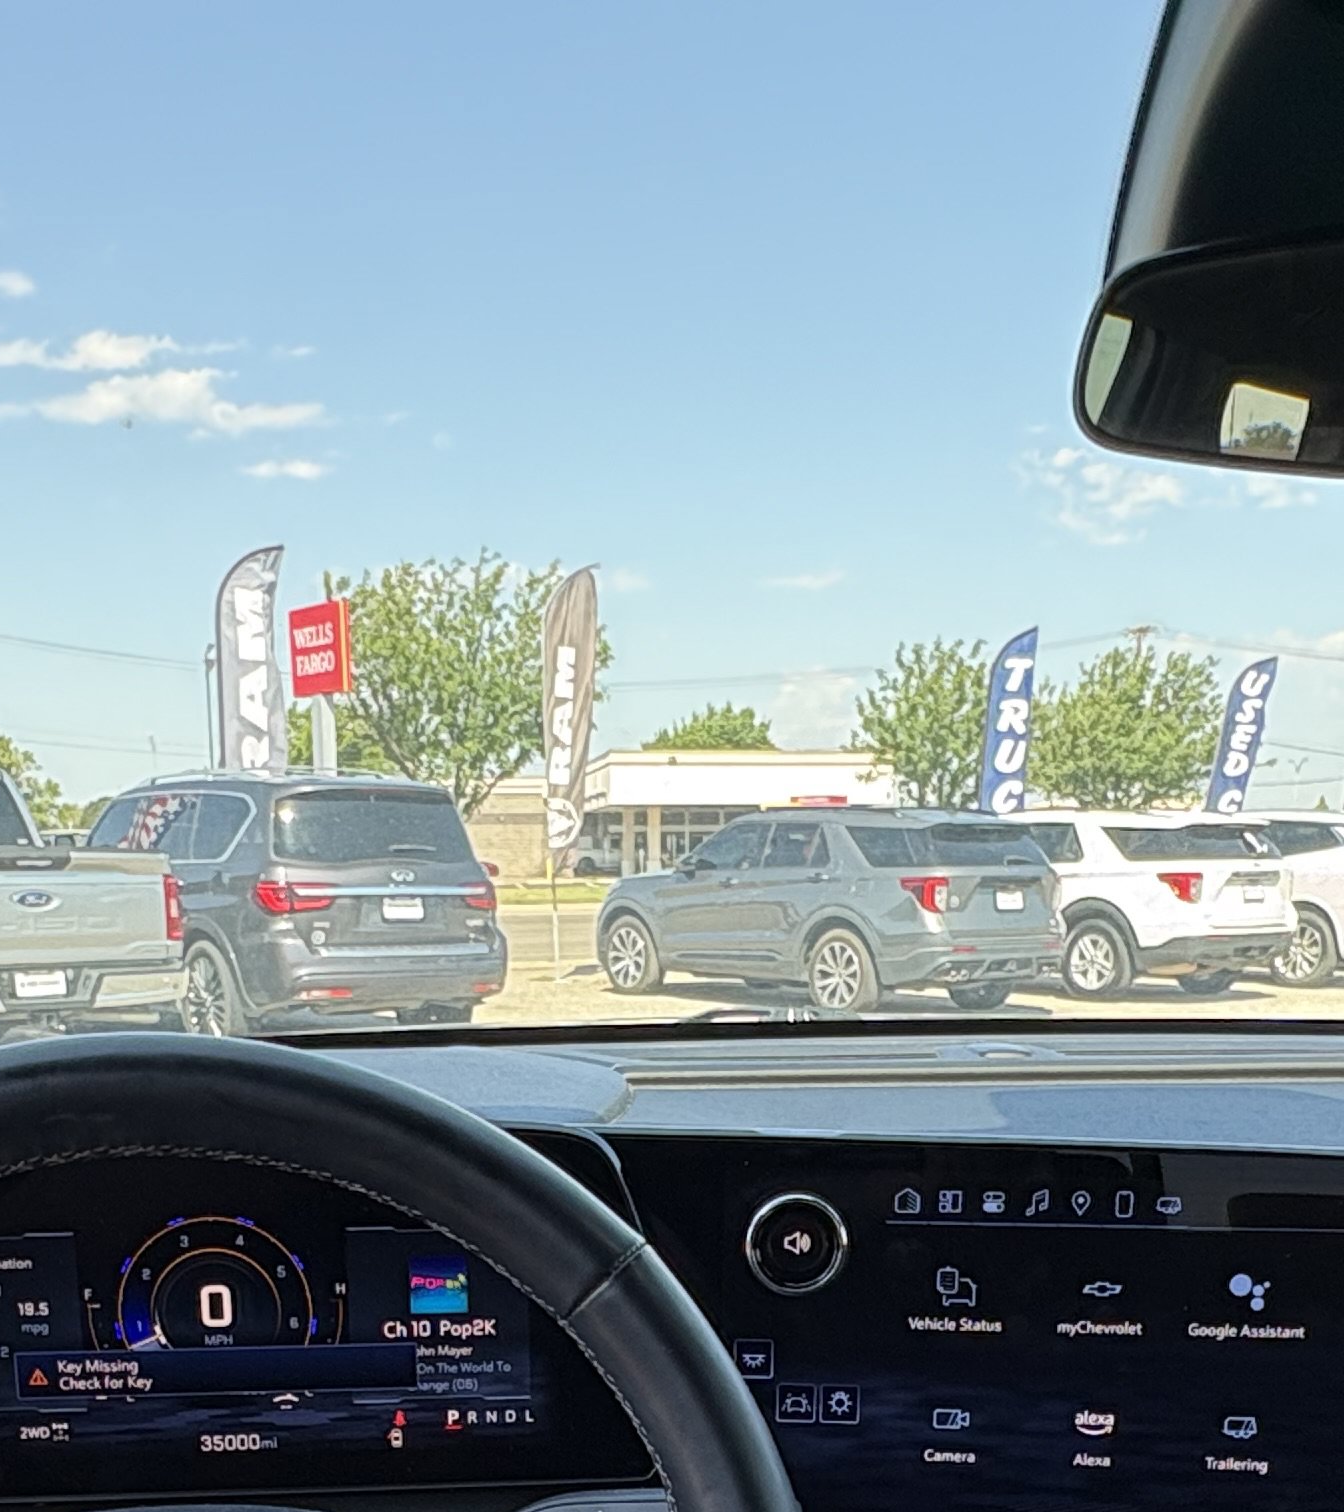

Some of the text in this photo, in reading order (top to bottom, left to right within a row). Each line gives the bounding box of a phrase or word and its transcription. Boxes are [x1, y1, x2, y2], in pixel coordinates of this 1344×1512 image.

[293, 621, 334, 650] WELLS
[295, 650, 335, 678] FARGO
[1222, 670, 1270, 778] USED
[180, 1236, 189, 1248] 3
[235, 1235, 244, 1247] 4
[142, 1268, 151, 1280] 2
[84, 1288, 93, 1301] F
[336, 1282, 346, 1295] H
[200, 1284, 233, 1328] 0
[21, 1323, 50, 1336] mpg
[383, 1318, 497, 1340] Ch 10 Pop2K
[908, 1316, 1003, 1333] Vehicle Status
[1056, 1320, 1144, 1339] myChevrolet
[1187, 1322, 1306, 1341] Google Assistant
[204, 1335, 233, 1347] MPH
[0, 1346, 10, 1358] 2
[437, 1345, 473, 1359] Mayer
[57, 1359, 139, 1375] Key Missing
[437, 1362, 458, 1374] The
[460, 1360, 494, 1373] World
[496, 1360, 512, 1372] To
[59, 1375, 154, 1392] Check for Key
[447, 1410, 535, 1424] P R N D L
[1074, 1410, 1116, 1428] alexa
[19, 1427, 50, 1440] 2WD
[923, 1448, 977, 1465] Camera
[1072, 1452, 1112, 1469] Alexa
[1204, 1456, 1269, 1475] Trailering
